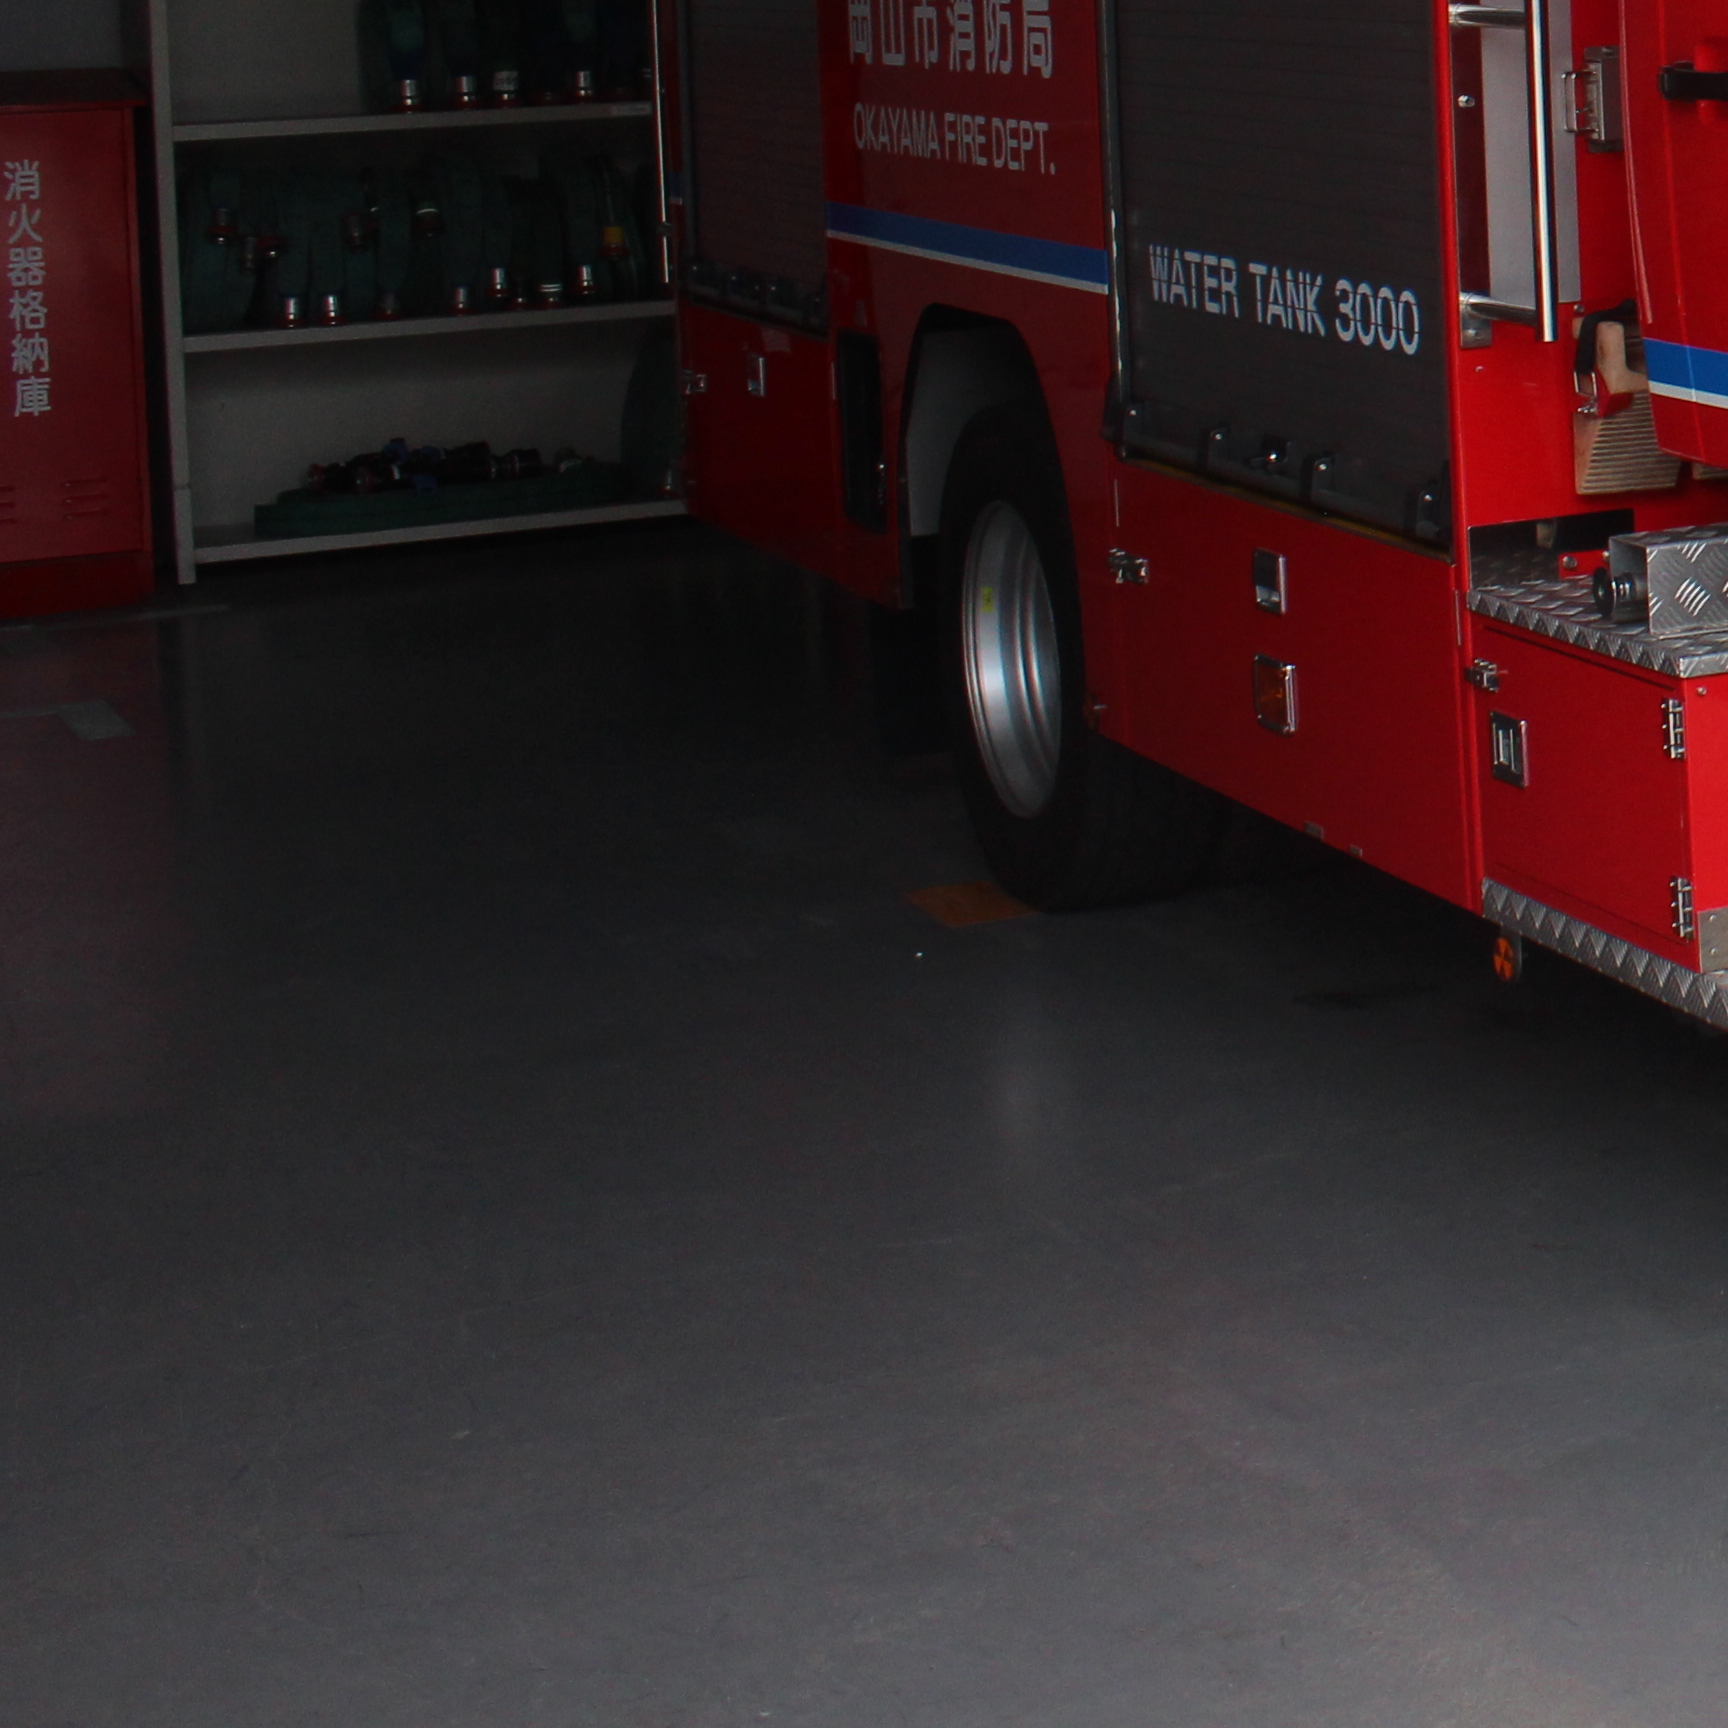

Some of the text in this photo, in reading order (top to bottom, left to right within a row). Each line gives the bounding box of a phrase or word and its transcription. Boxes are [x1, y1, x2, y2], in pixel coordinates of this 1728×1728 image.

[853, 101, 1056, 176] OKAYAMA FIRE DEPT.
[3, 158, 52, 419] 消火器格納庫
[1149, 243, 1421, 356] WATER TANK 3000
